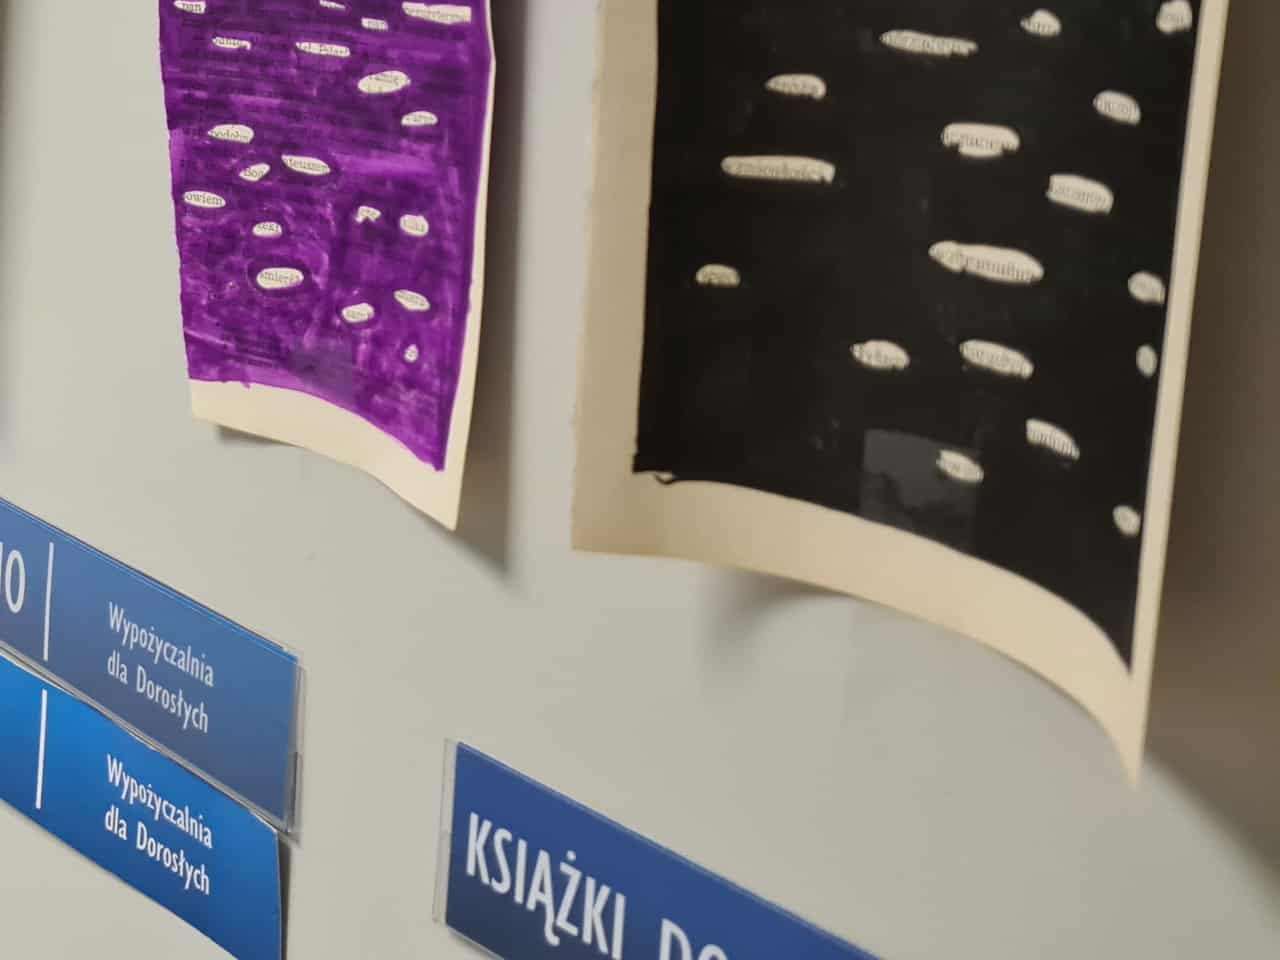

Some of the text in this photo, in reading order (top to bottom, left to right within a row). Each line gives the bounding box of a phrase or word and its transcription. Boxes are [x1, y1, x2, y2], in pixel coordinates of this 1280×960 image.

[109, 600, 215, 688] Wypożyczalnia
[107, 655, 209, 734] dla Dorosłych
[107, 752, 213, 849] Wypożyczalnia
[104, 804, 210, 895] dla Dorosłych
[466, 811, 627, 960] KSIĄŻKI
